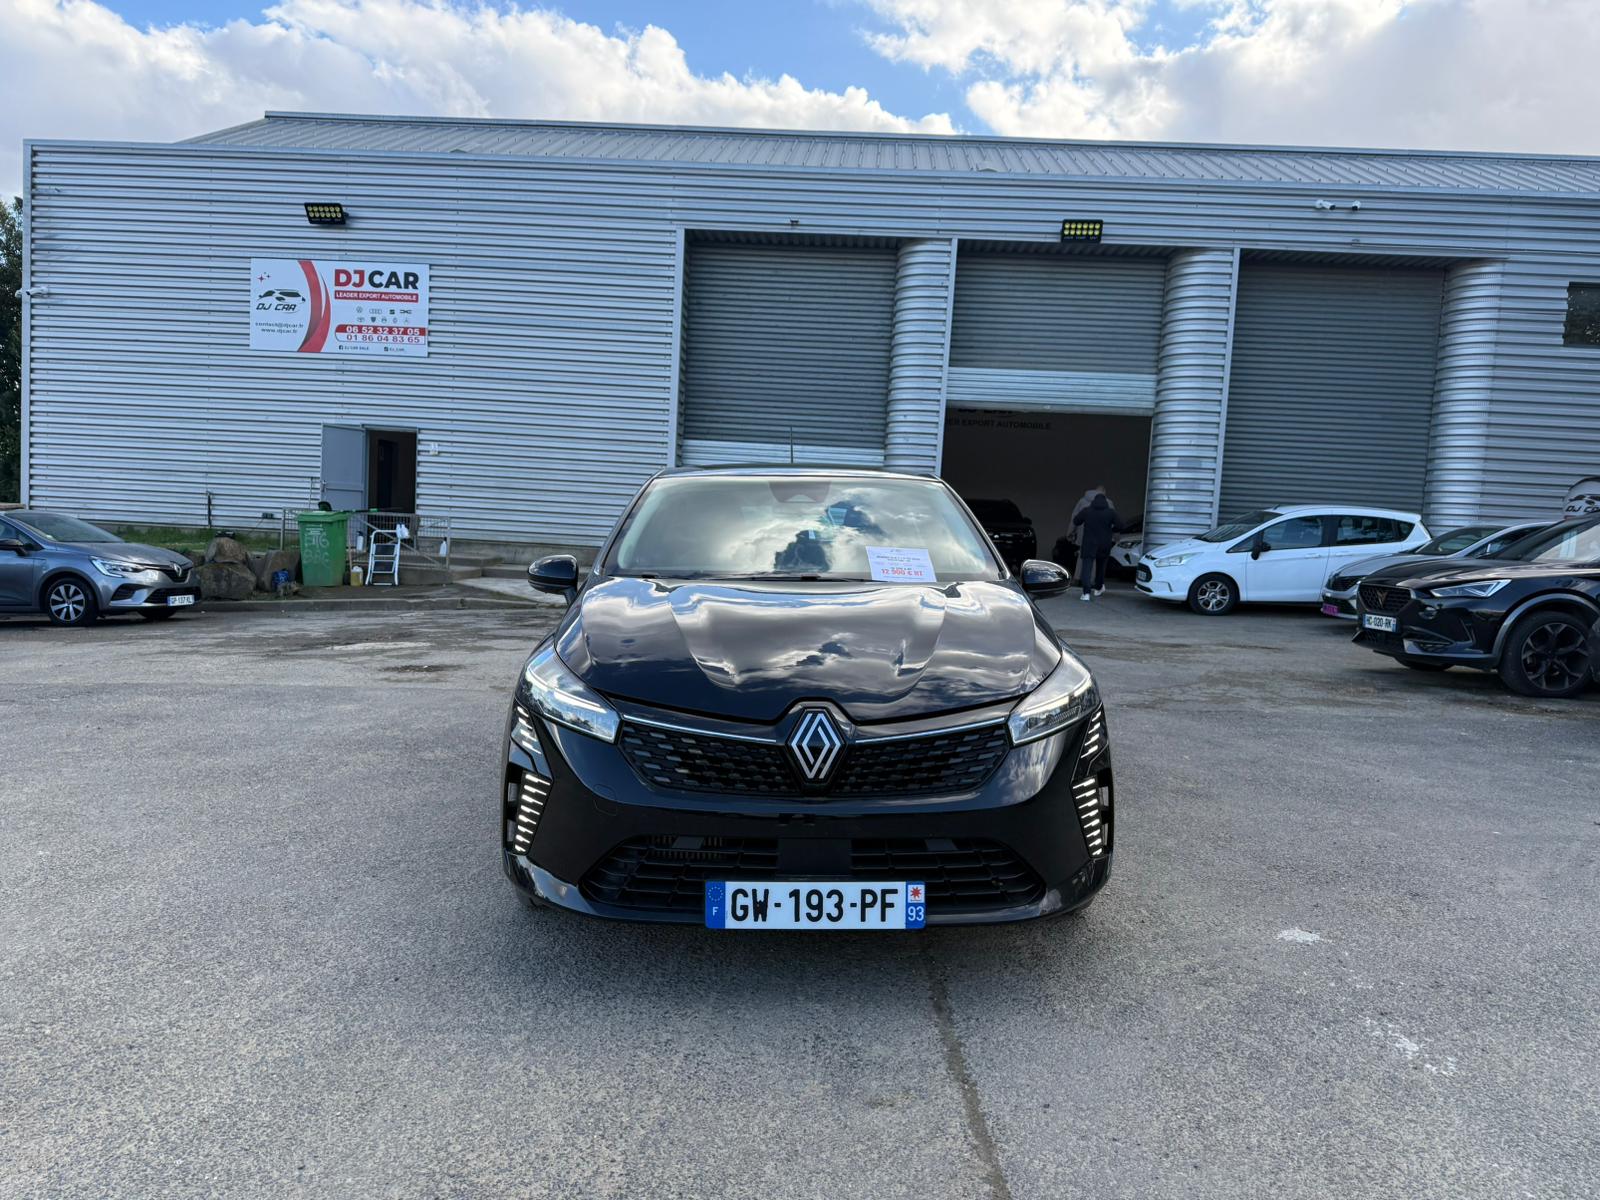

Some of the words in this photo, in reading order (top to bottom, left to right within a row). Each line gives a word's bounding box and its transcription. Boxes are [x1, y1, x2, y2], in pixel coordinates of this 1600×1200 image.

[335, 269, 364, 288] DJ
[368, 270, 419, 290] CAR
[256, 303, 272, 311] DJ
[275, 303, 297, 312] CAR
[346, 325, 359, 333] 06
[362, 326, 374, 334] 52
[377, 327, 389, 335] 32
[392, 327, 405, 335] 37
[407, 328, 420, 336] 05
[712, 906, 719, 916] F
[731, 888, 898, 922] GW-193-PF
[907, 906, 924, 921] 93
